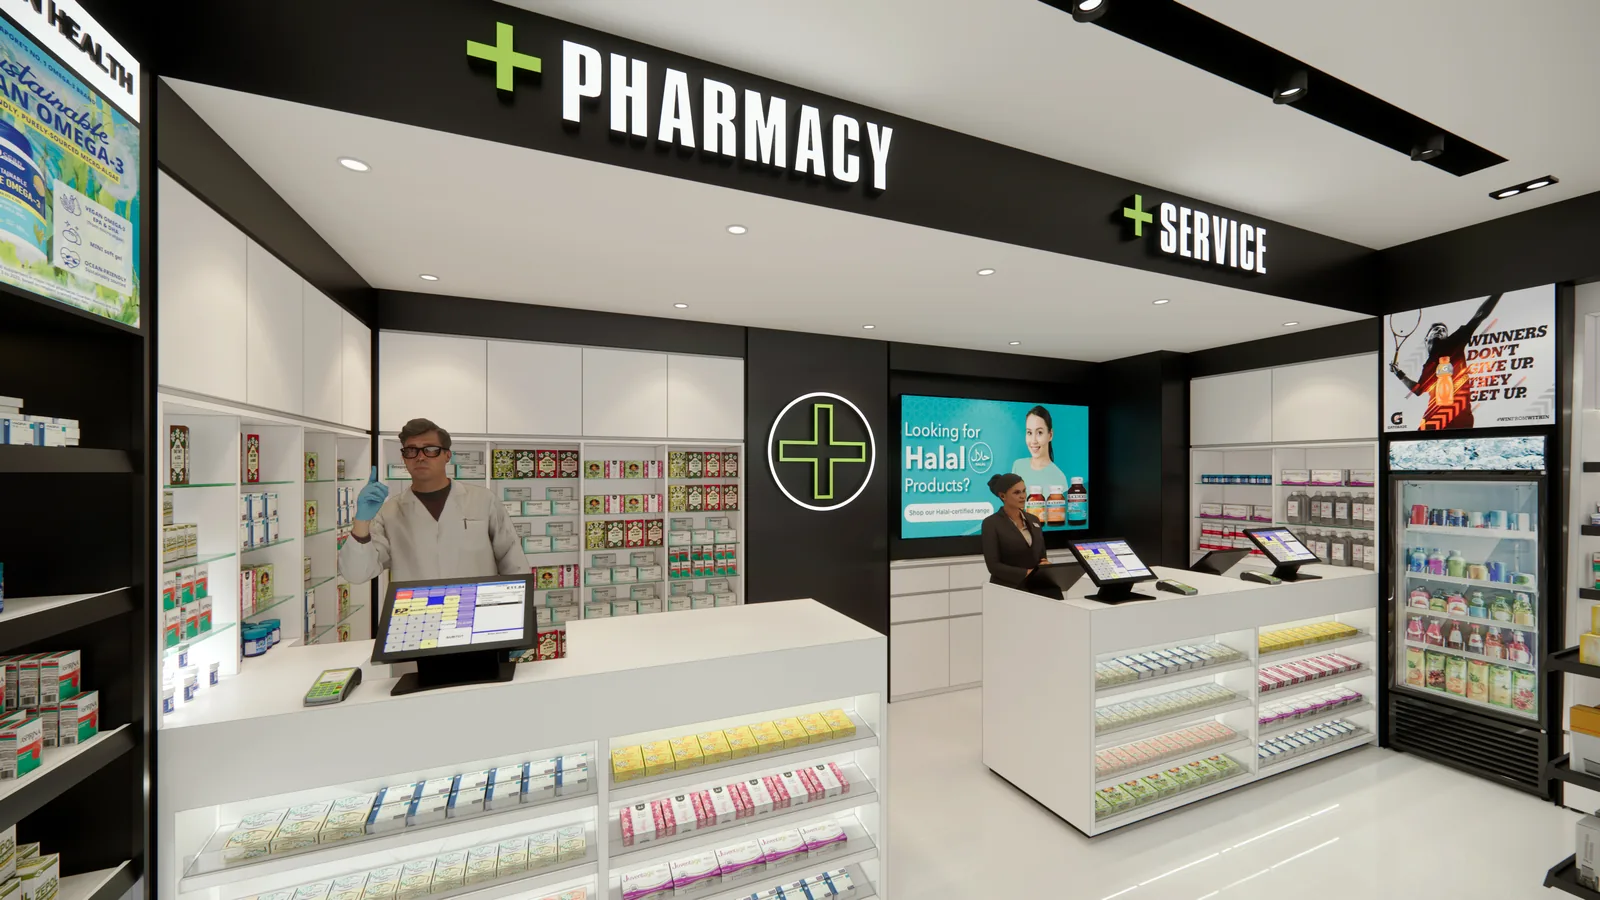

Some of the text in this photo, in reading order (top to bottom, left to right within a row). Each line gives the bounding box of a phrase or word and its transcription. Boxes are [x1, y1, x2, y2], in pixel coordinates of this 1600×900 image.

[47, 0, 133, 95] HEALTH
[562, 40, 893, 190] PHARMACY
[21, 114, 79, 155] PURELY-SOURCED
[80, 153, 119, 182] MICRO-ALGAE
[37, 103, 124, 174] OMEGA-3
[85, 205, 103, 219] VEGAN
[1160, 202, 1267, 275] SERVICE
[115, 252, 123, 261] gel
[84, 260, 127, 282] OCEAN-FRIENDLY
[1468, 325, 1548, 347] WINNERS
[1467, 343, 1519, 361] DON'T
[1468, 357, 1534, 375] GIVE UP.
[1469, 374, 1512, 389] THEY
[1470, 387, 1527, 402] GET UP.
[1391, 412, 1403, 425] G
[905, 422, 981, 442] Looking for
[905, 445, 965, 470] Halal
[905, 477, 970, 493] Products?
